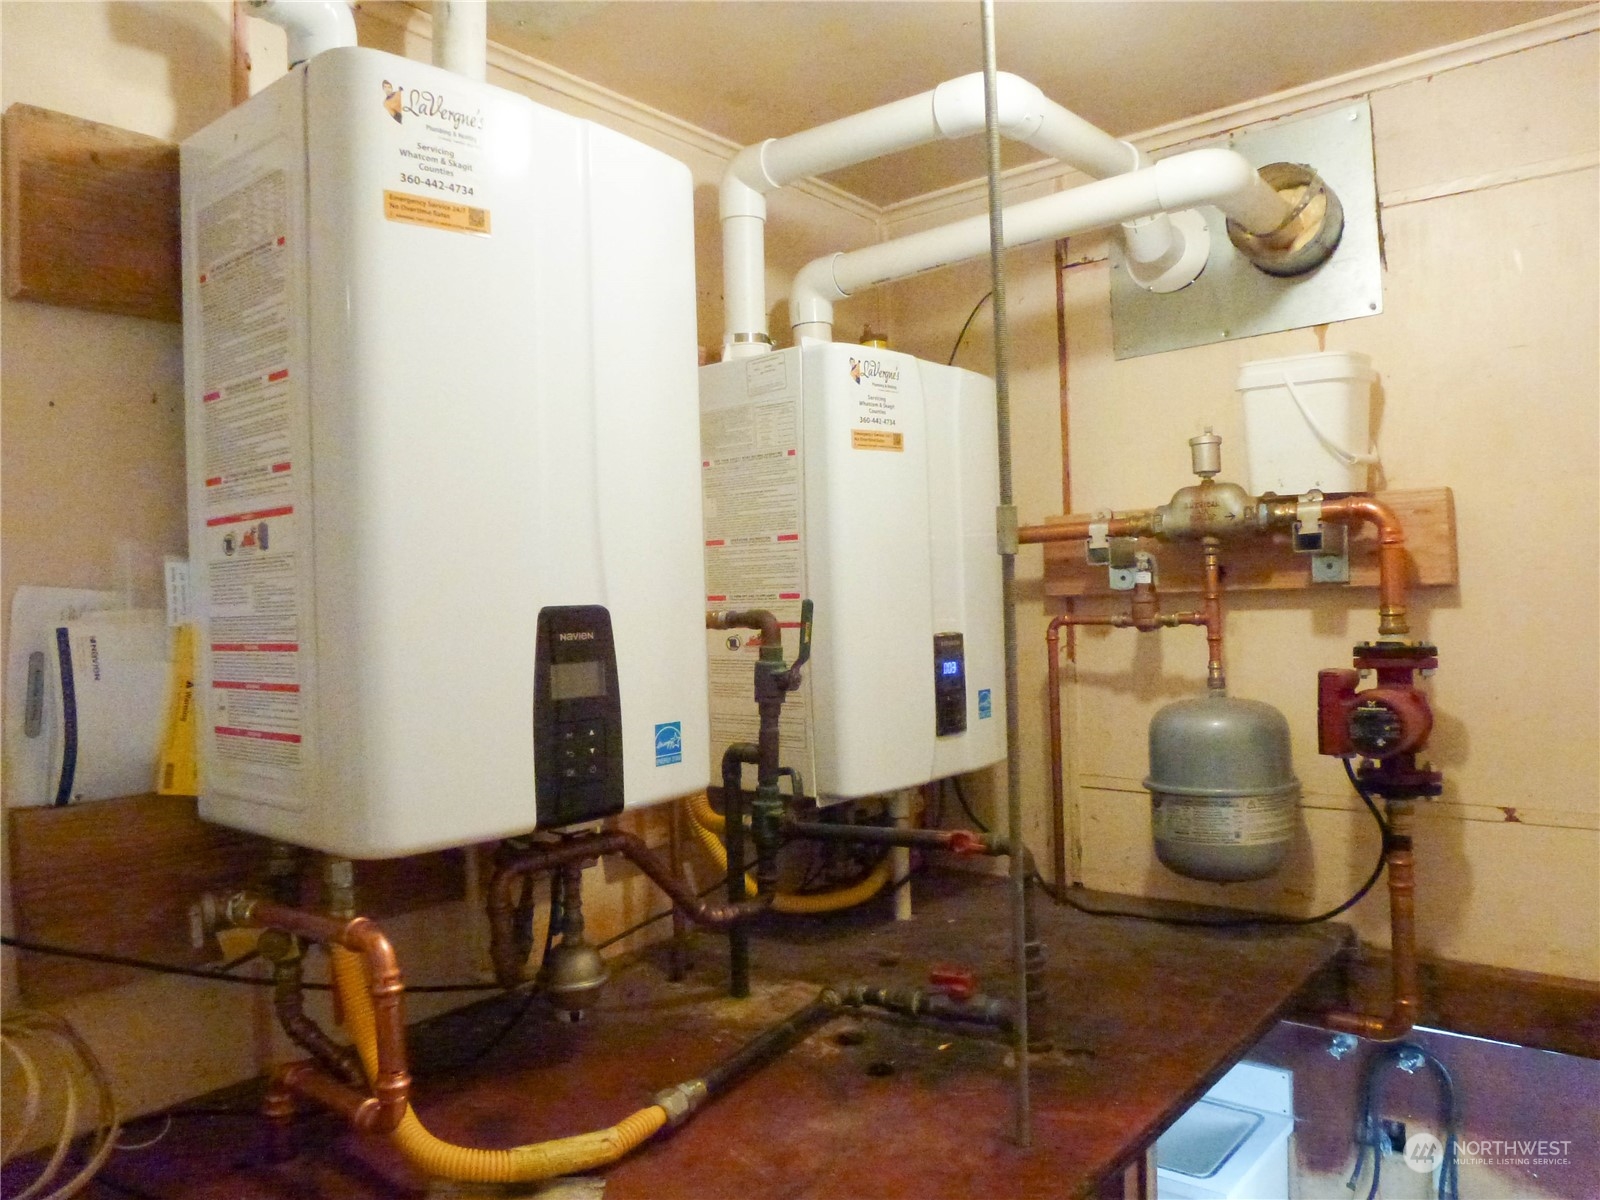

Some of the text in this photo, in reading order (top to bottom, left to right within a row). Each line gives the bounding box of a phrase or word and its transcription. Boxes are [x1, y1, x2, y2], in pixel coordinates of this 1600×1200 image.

[402, 89, 484, 129] LaVergne's
[399, 148, 473, 172] Whatcom & Skagit
[417, 142, 455, 158] Servicing
[418, 163, 454, 177] Counties
[400, 173, 474, 196] 360-442-4734
[861, 360, 900, 383] LaVergne's
